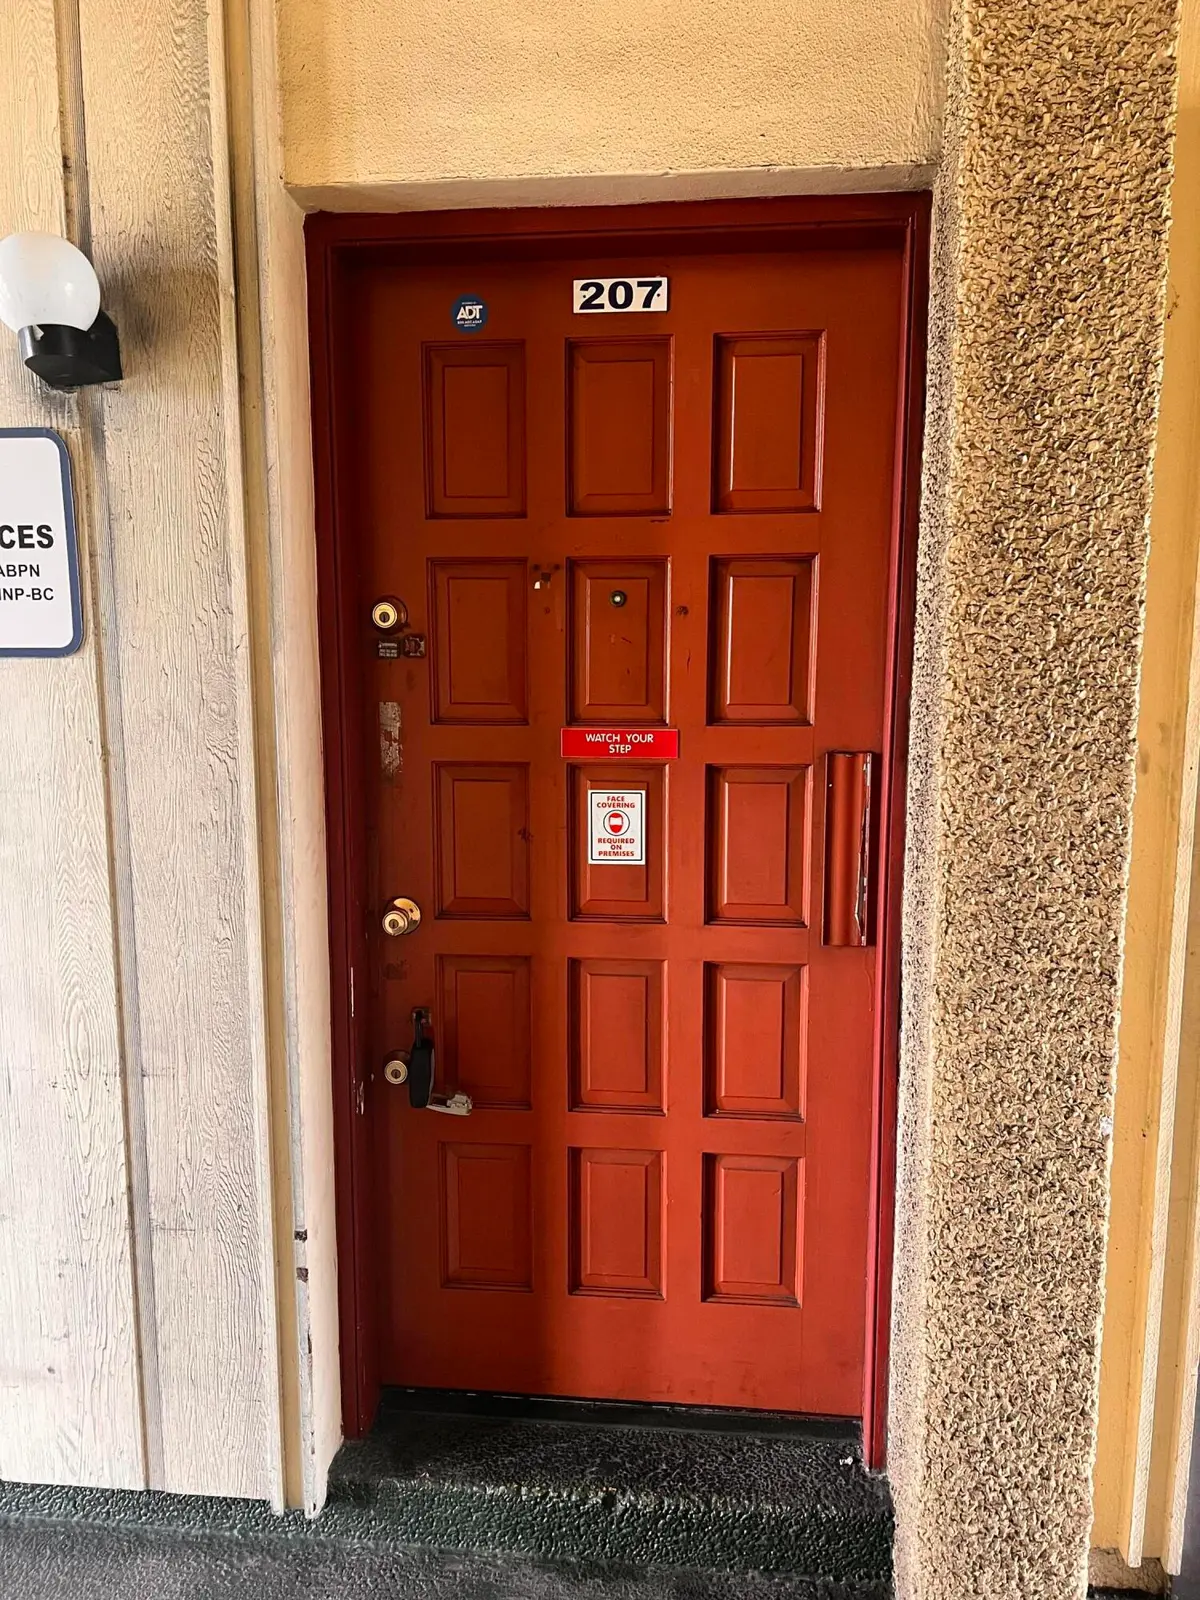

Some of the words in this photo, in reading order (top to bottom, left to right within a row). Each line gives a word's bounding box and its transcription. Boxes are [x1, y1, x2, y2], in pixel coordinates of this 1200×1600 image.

[579, 280, 662, 310] 207
[456, 305, 483, 320] ADT
[0, 524, 54, 549] CES
[0, 587, 54, 601] NP-BC
[585, 733, 620, 743] WATCH
[626, 733, 654, 743] YOUR
[608, 744, 632, 754] STEP
